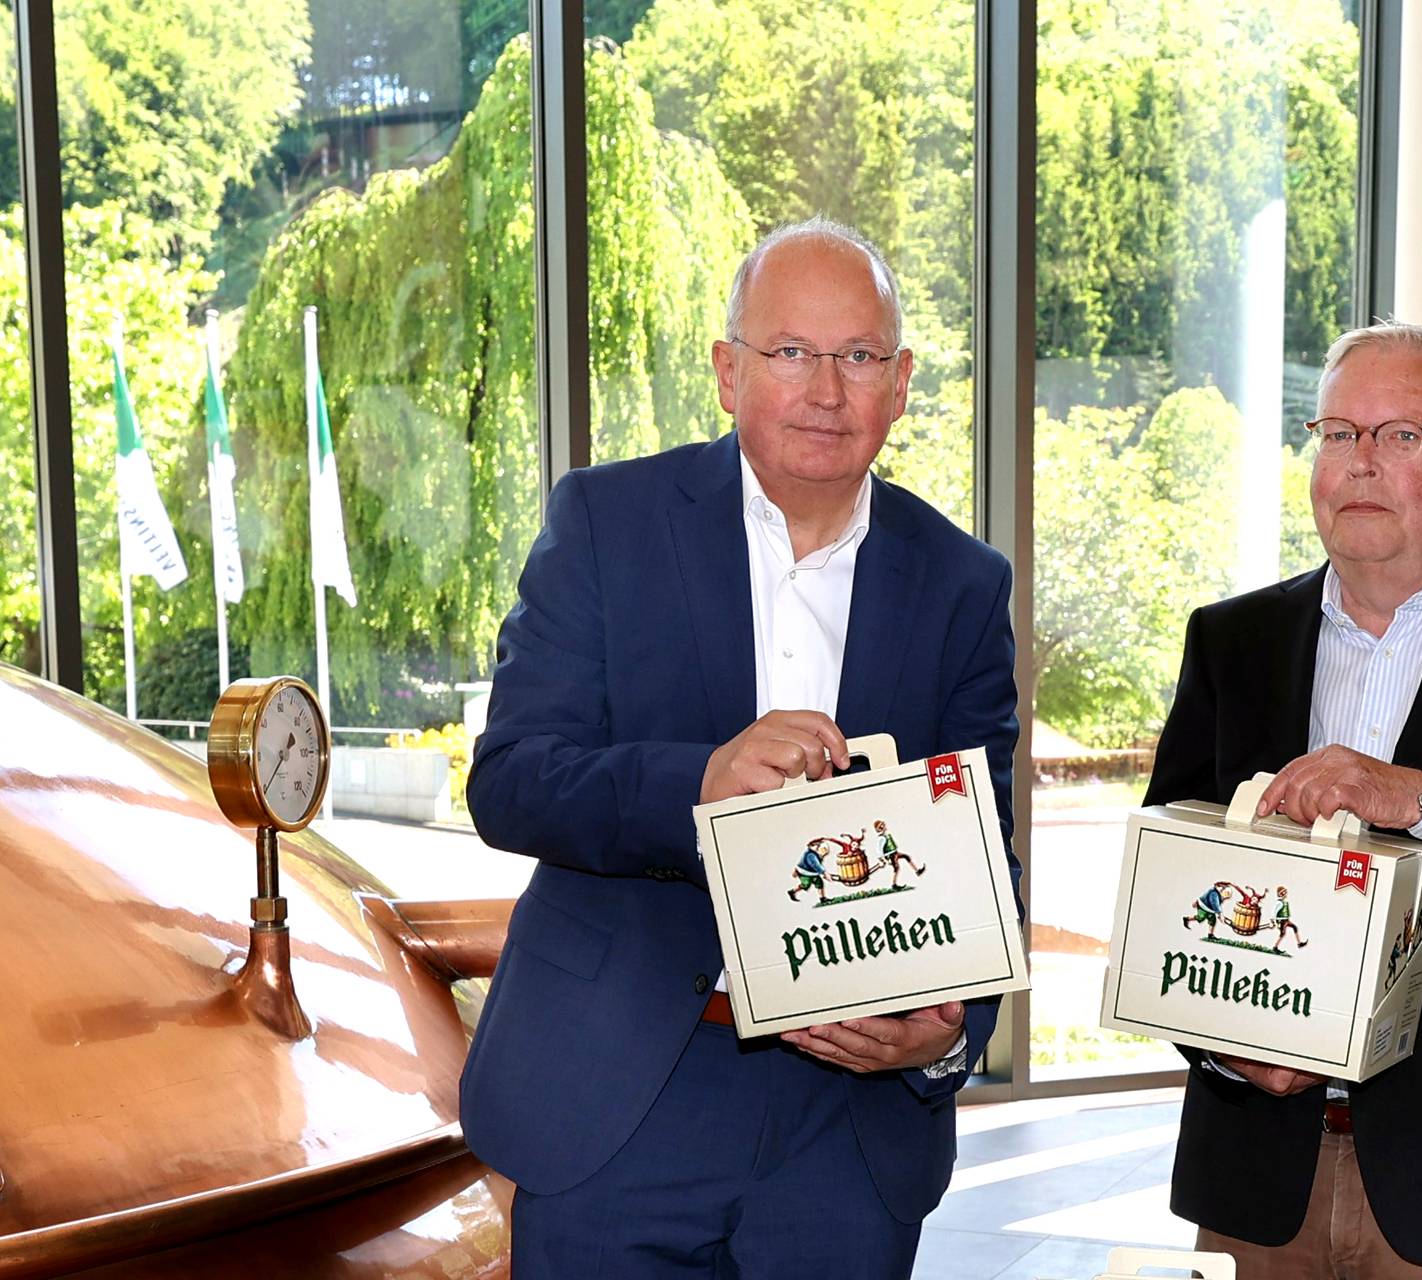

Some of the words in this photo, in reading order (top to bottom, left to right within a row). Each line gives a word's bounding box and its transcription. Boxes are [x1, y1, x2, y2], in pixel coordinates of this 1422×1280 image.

[935, 764, 955, 776] FÜR
[934, 774, 958, 786] DICH
[1346, 859, 1364, 871] FÜR
[1343, 868, 1364, 880] DICH
[781, 910, 956, 982] Pülleken
[1160, 951, 1312, 1018] Pülleken
